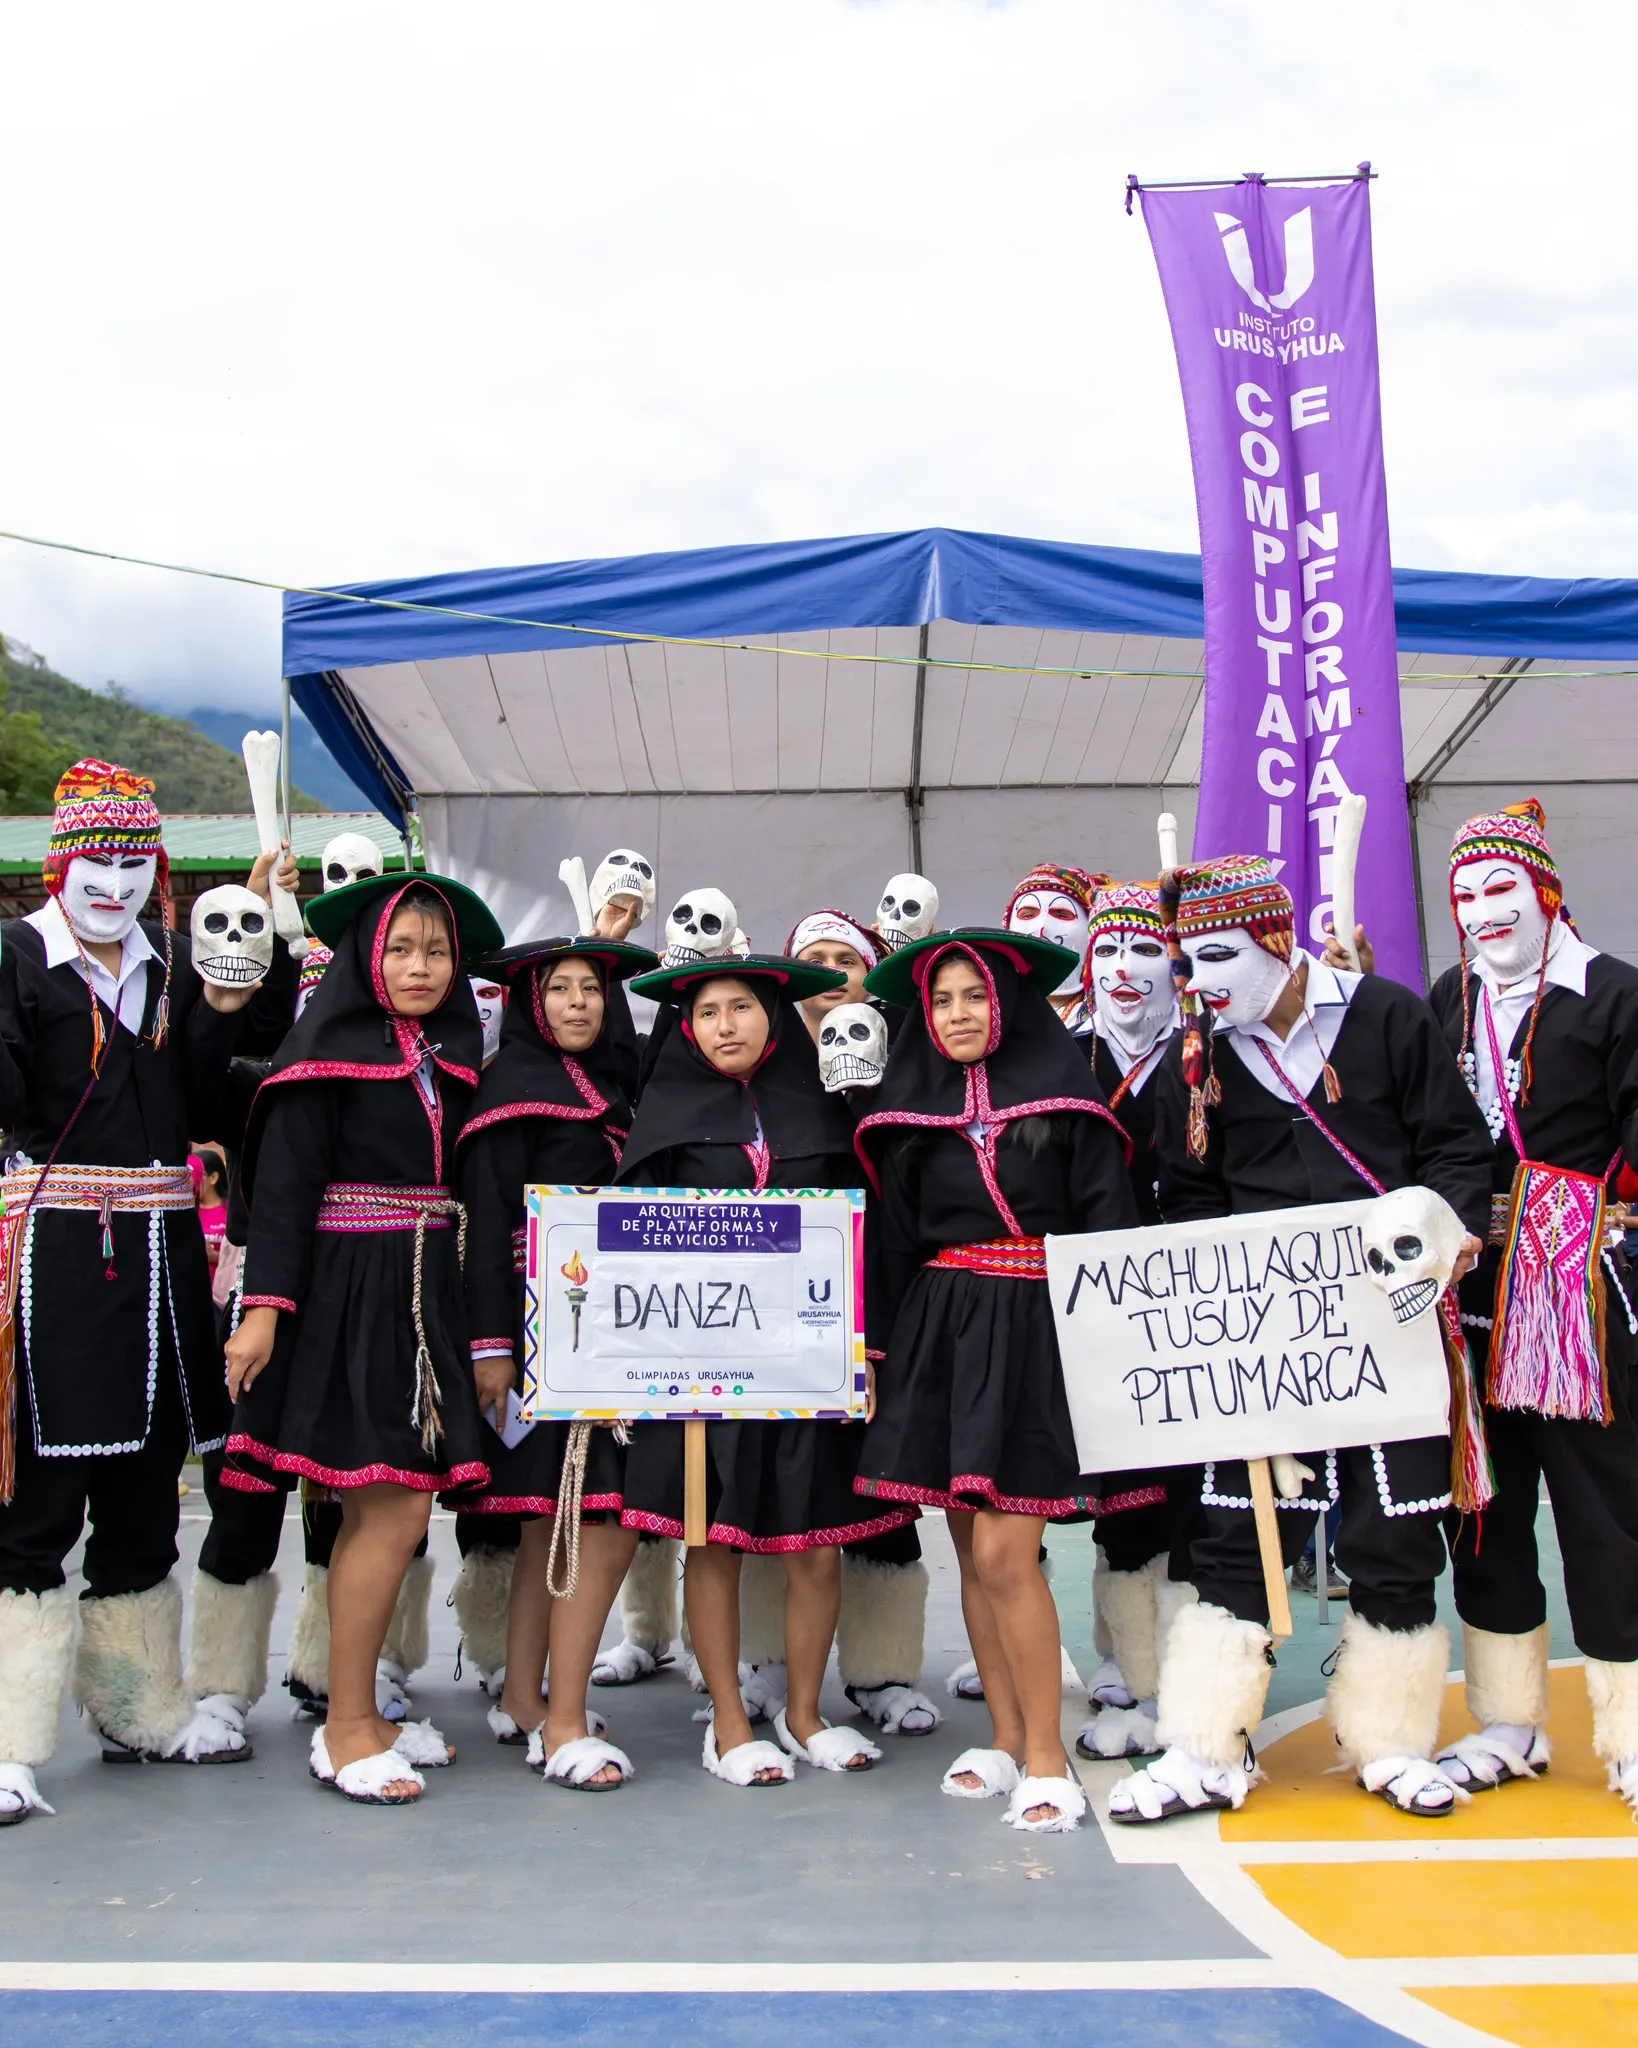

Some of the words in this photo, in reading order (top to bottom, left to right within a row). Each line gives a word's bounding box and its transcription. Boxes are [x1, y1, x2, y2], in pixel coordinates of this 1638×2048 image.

[1238, 311, 1316, 341] INSTTUTO
[1213, 327, 1346, 366] URUSYHUA
[1290, 385, 1331, 432] E
[1235, 382, 1298, 878] COMPUTACI
[621, 1219, 641, 1232] DE
[646, 1220, 764, 1233] PLATAFORMAS
[769, 1221, 779, 1233] Y
[638, 1205, 762, 1219] ARQUITECTURA
[642, 1233, 728, 1247] SERVICIOS
[734, 1235, 756, 1247] TI.
[613, 1281, 762, 1331] DANZA
[797, 1310, 842, 1318] URUSAYHUA
[1127, 1293, 1275, 1352] TUSUY
[1288, 1284, 1348, 1342] DE
[626, 1371, 690, 1380] OLIMPIADAS
[697, 1371, 755, 1381] URUSAYHUA
[1121, 1343, 1388, 1426] PITUMARCA
